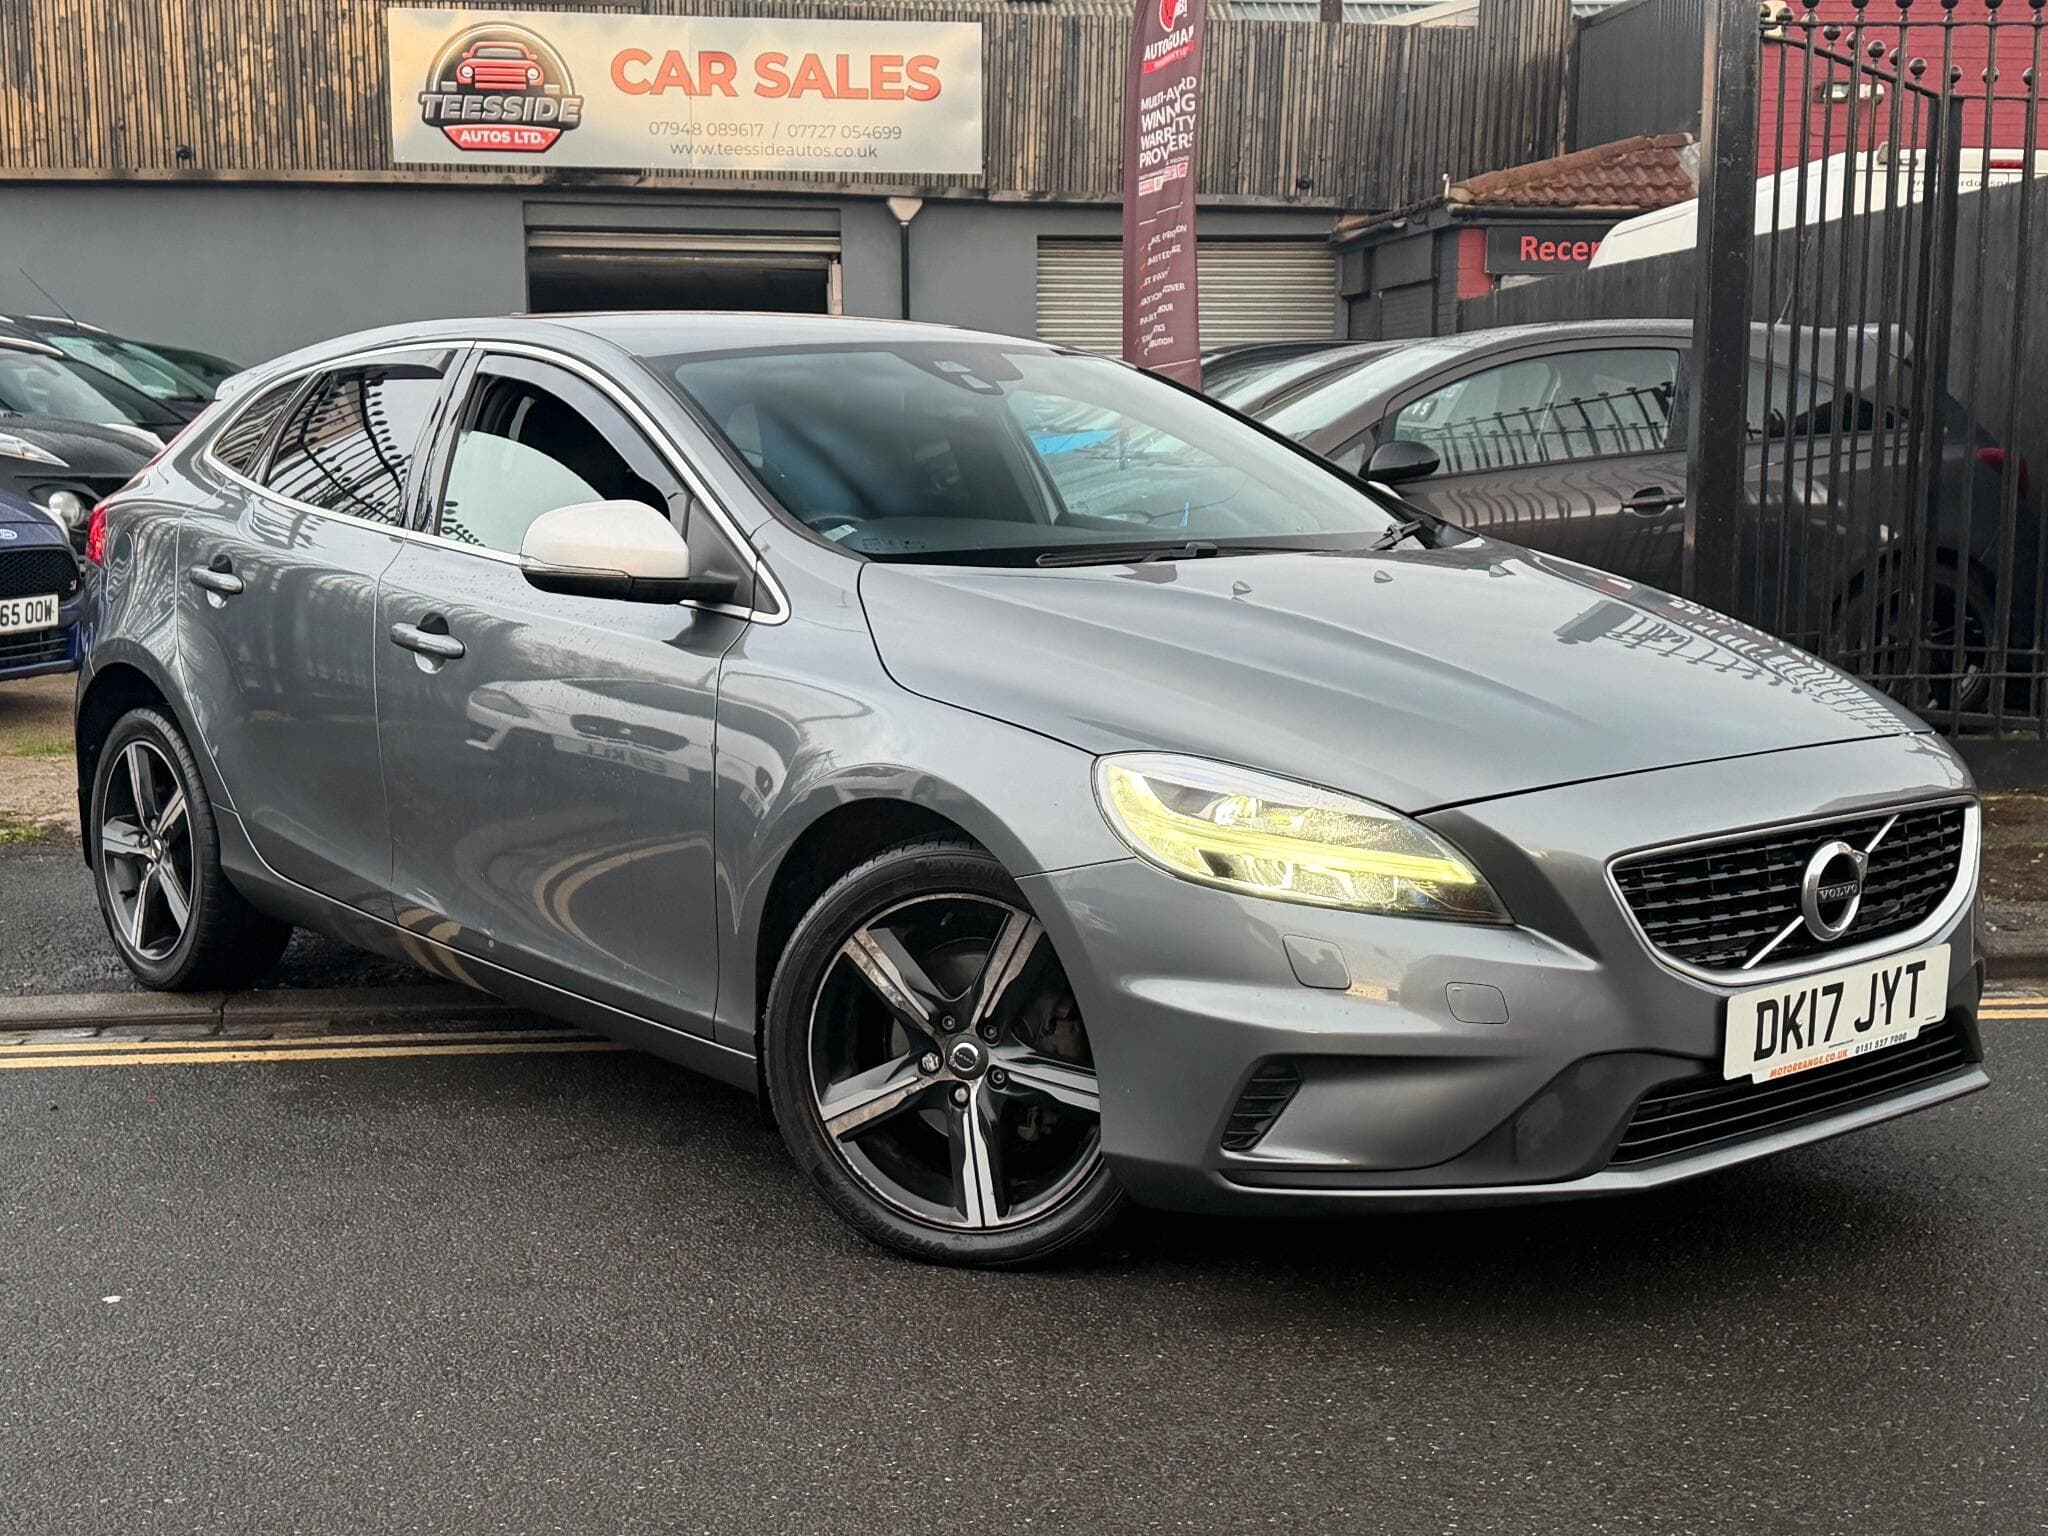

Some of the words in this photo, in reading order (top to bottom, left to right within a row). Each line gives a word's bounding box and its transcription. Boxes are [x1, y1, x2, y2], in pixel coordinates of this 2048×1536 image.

[610, 47, 739, 97] CAR
[753, 52, 942, 101] SALES
[421, 94, 583, 123] TEESSIDE
[460, 130, 511, 144] AUTOS
[514, 132, 546, 145] LTD.
[648, 121, 703, 136] 07948
[706, 122, 764, 137] 089617
[787, 124, 836, 139] 07727
[841, 125, 903, 140] 054699
[670, 142, 879, 159] www.teessideautos.co.uk
[1819, 884, 1857, 900] VOLVO
[1753, 981, 1844, 1062] DK17
[1854, 960, 1927, 1033] JYT
